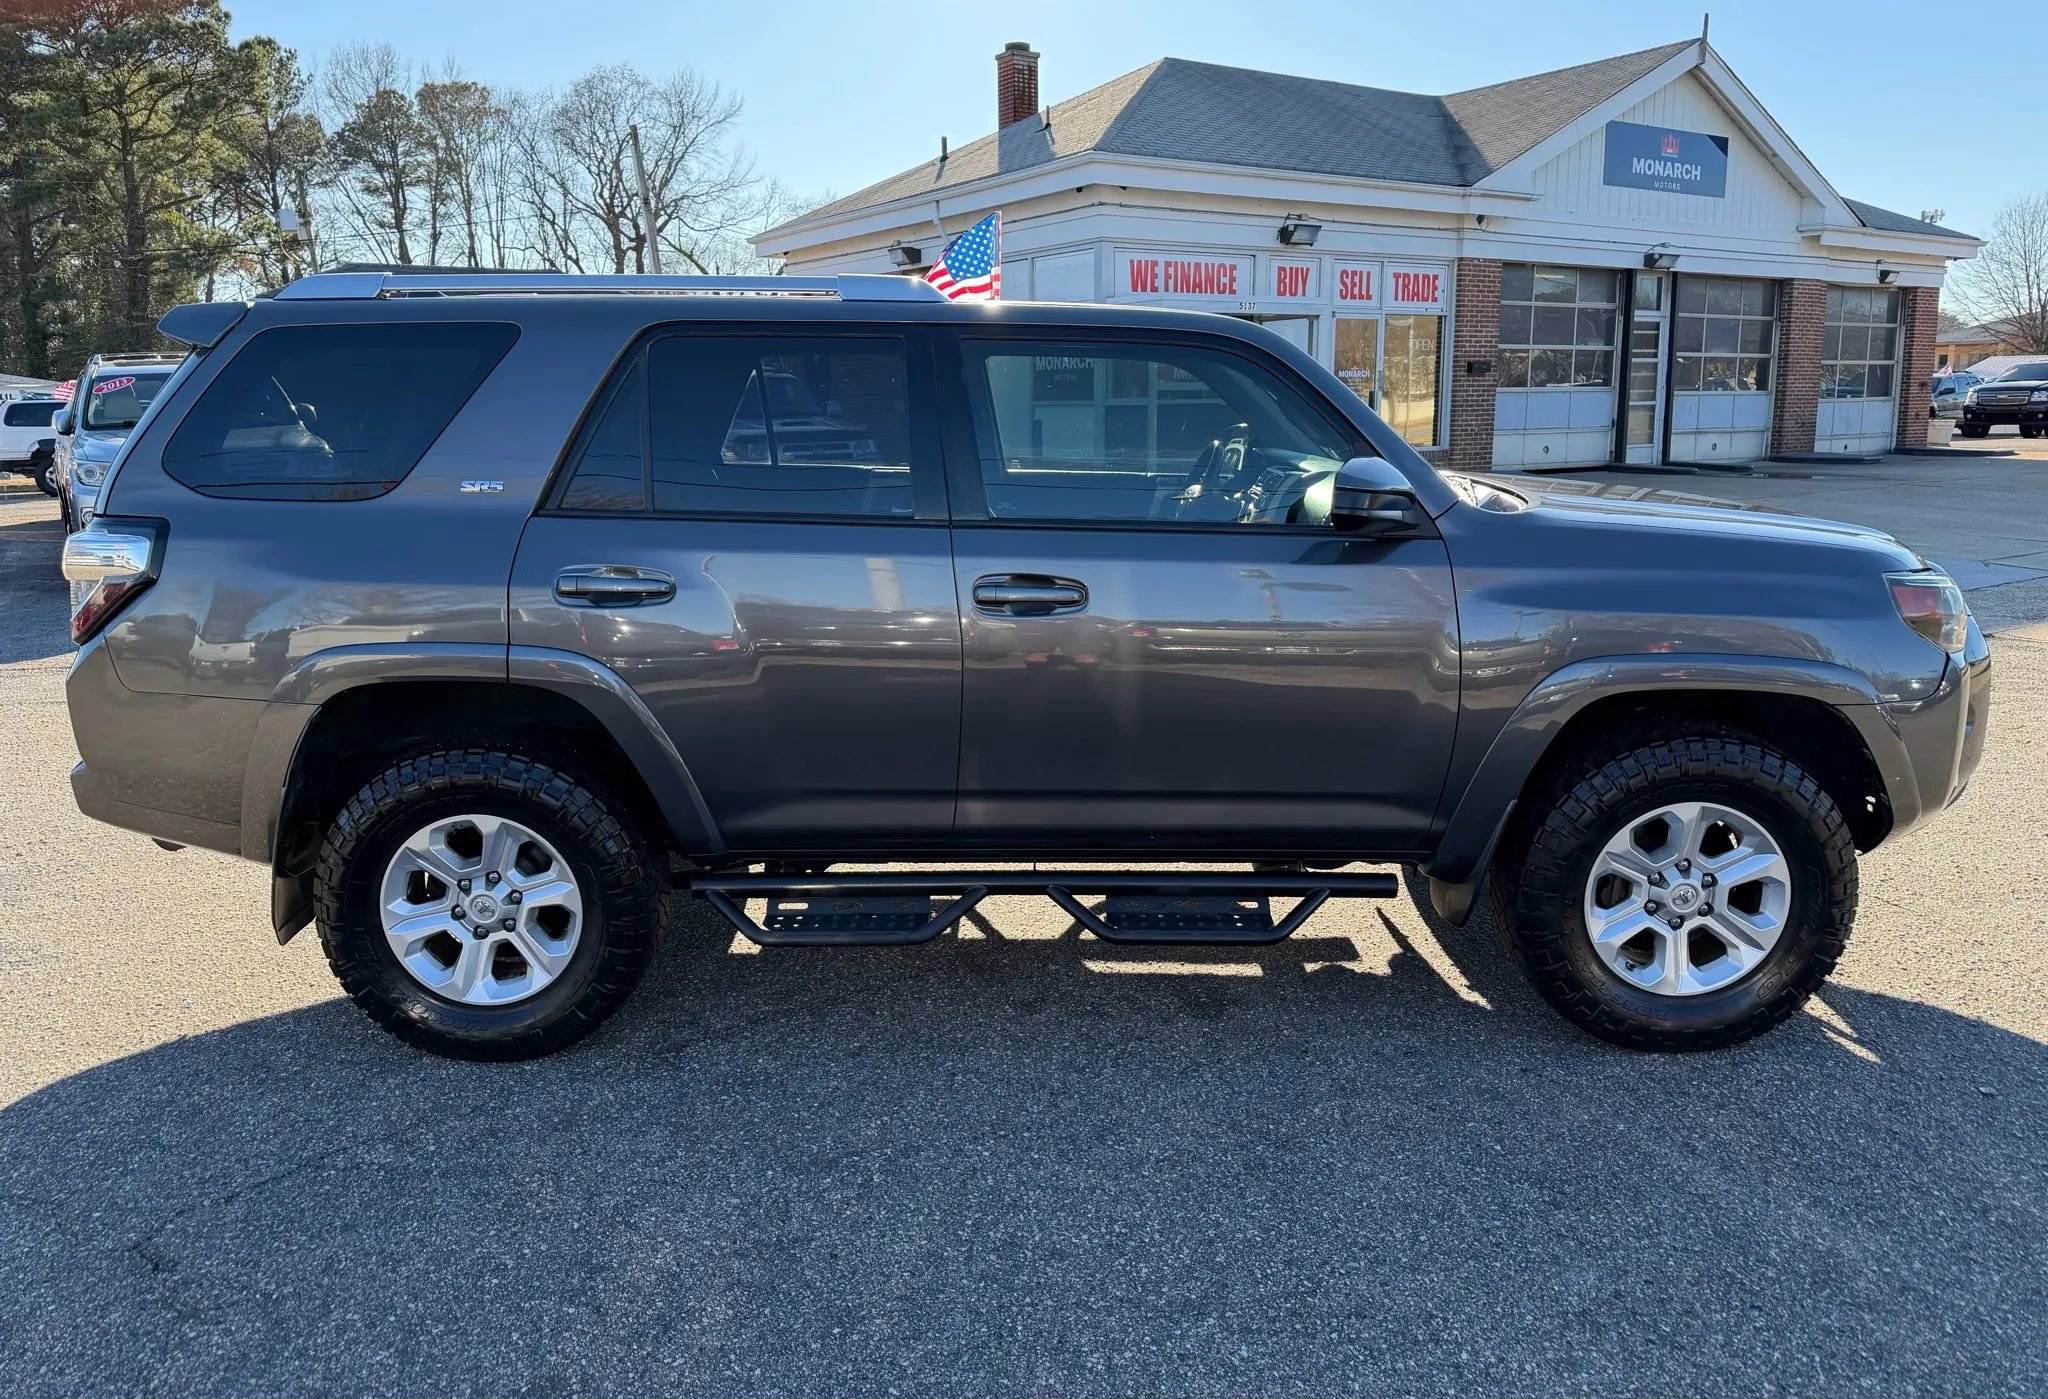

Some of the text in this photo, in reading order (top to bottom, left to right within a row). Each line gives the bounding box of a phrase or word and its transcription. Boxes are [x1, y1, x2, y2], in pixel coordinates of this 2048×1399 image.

[1632, 157, 1701, 181] MONARCH
[1654, 181, 1681, 190] MOTORS
[1129, 259, 1237, 295] WE FINANCE
[1276, 266, 1311, 298] BUY
[1339, 269, 1373, 301] SELL
[1392, 272, 1439, 303] TRADE
[1239, 302, 1256, 310] 5137
[1036, 356, 1093, 371] MONARCH
[1338, 370, 1370, 378] MONARCH
[102, 378, 128, 393] 2013
[460, 480, 505, 493] SR5
